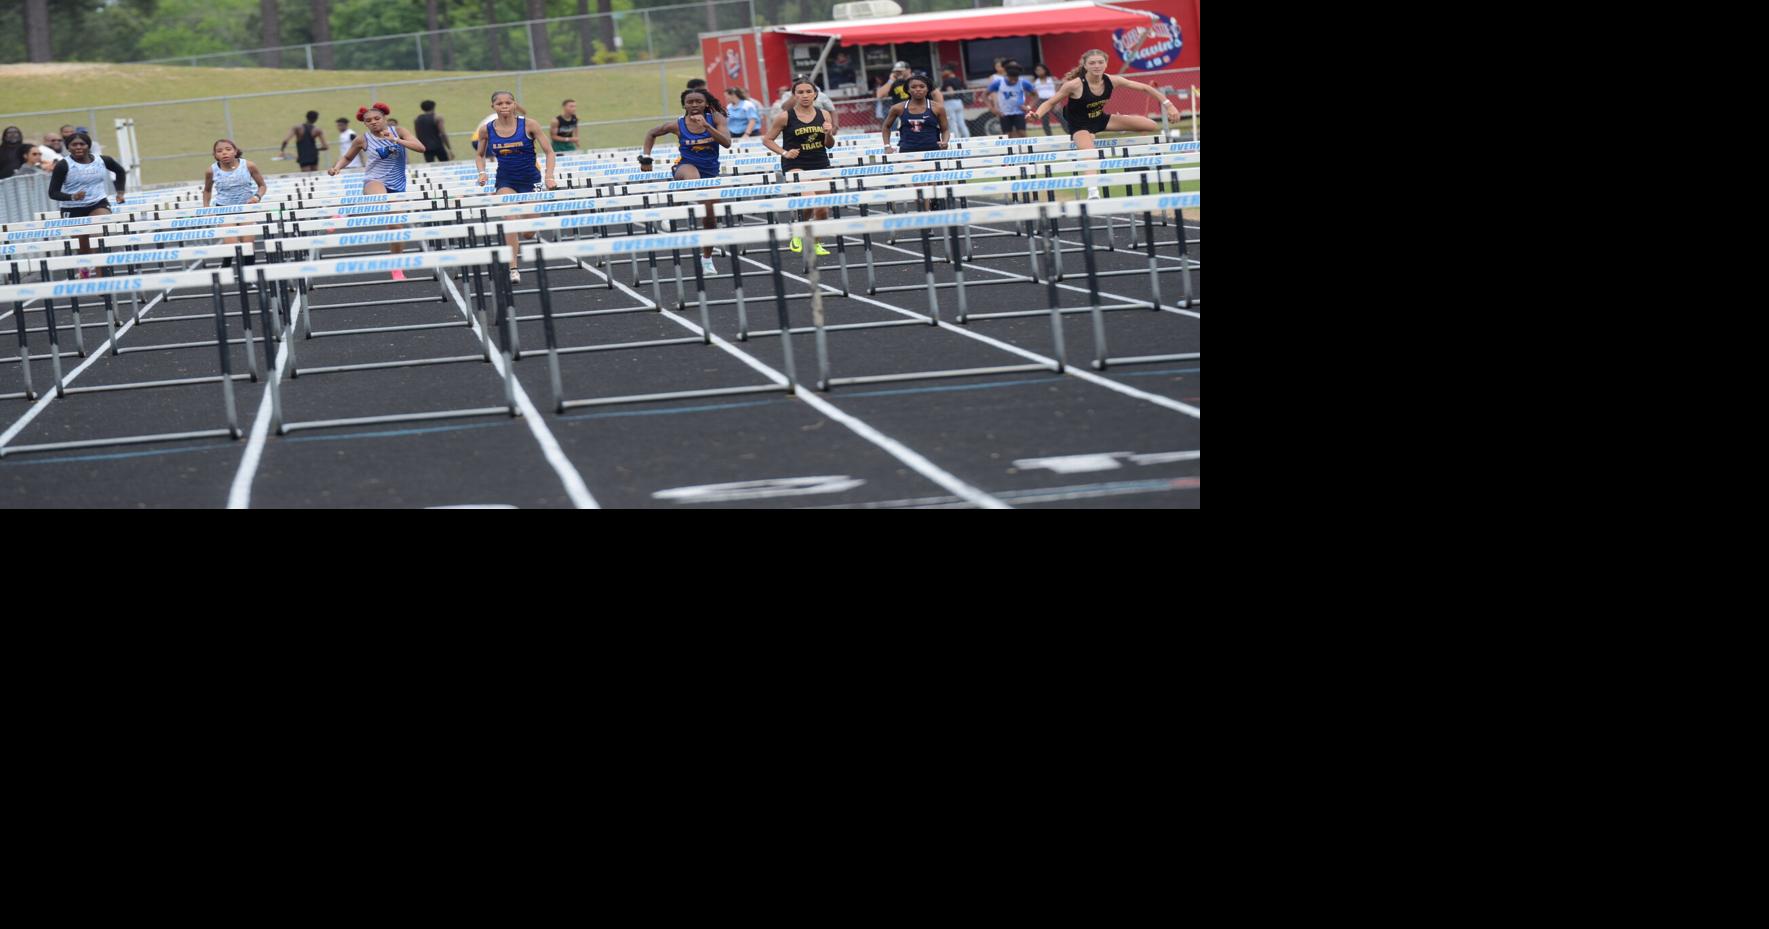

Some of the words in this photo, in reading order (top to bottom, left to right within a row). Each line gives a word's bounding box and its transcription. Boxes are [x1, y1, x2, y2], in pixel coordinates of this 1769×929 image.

[801, 142, 823, 150] TRACK
[924, 149, 971, 158] OVERHILLS
[1003, 153, 1057, 163] OVERHILLS
[735, 157, 777, 165] OVERHILLS
[1100, 157, 1162, 169] OVERHILLS
[604, 168, 642, 176] OVERHILL
[840, 166, 894, 176] OVERHILLS
[912, 171, 973, 183] OVERHILLS
[668, 179, 722, 189] OVERHILLS
[1011, 177, 1084, 192] OVERHILLS
[502, 192, 555, 203] OVERHILLS
[720, 186, 782, 198] OVERHILLS
[340, 195, 388, 204] OVERHILLS
[788, 194, 861, 208] OVERHILLS
[195, 206, 243, 215] OVERHILLS
[338, 204, 391, 214] OVERHILLS
[534, 200, 596, 212] OVERHILLS
[44, 217, 92, 228] OVERHILLS
[170, 217, 225, 228] OVERHILLS
[346, 215, 408, 227] OVERHILLS
[561, 213, 632, 227] OVERHILLS
[883, 210, 971, 229] OVERHILLS
[7, 229, 62, 240] OVERHILLS
[153, 229, 216, 242] OVERHILLS
[339, 230, 412, 245] OVERHILLS
[612, 234, 700, 252] OVERHILLS
[106, 250, 180, 265] OVERHILLS
[335, 256, 424, 273] OVERHILLS
[53, 278, 143, 296] OVERHILLS
